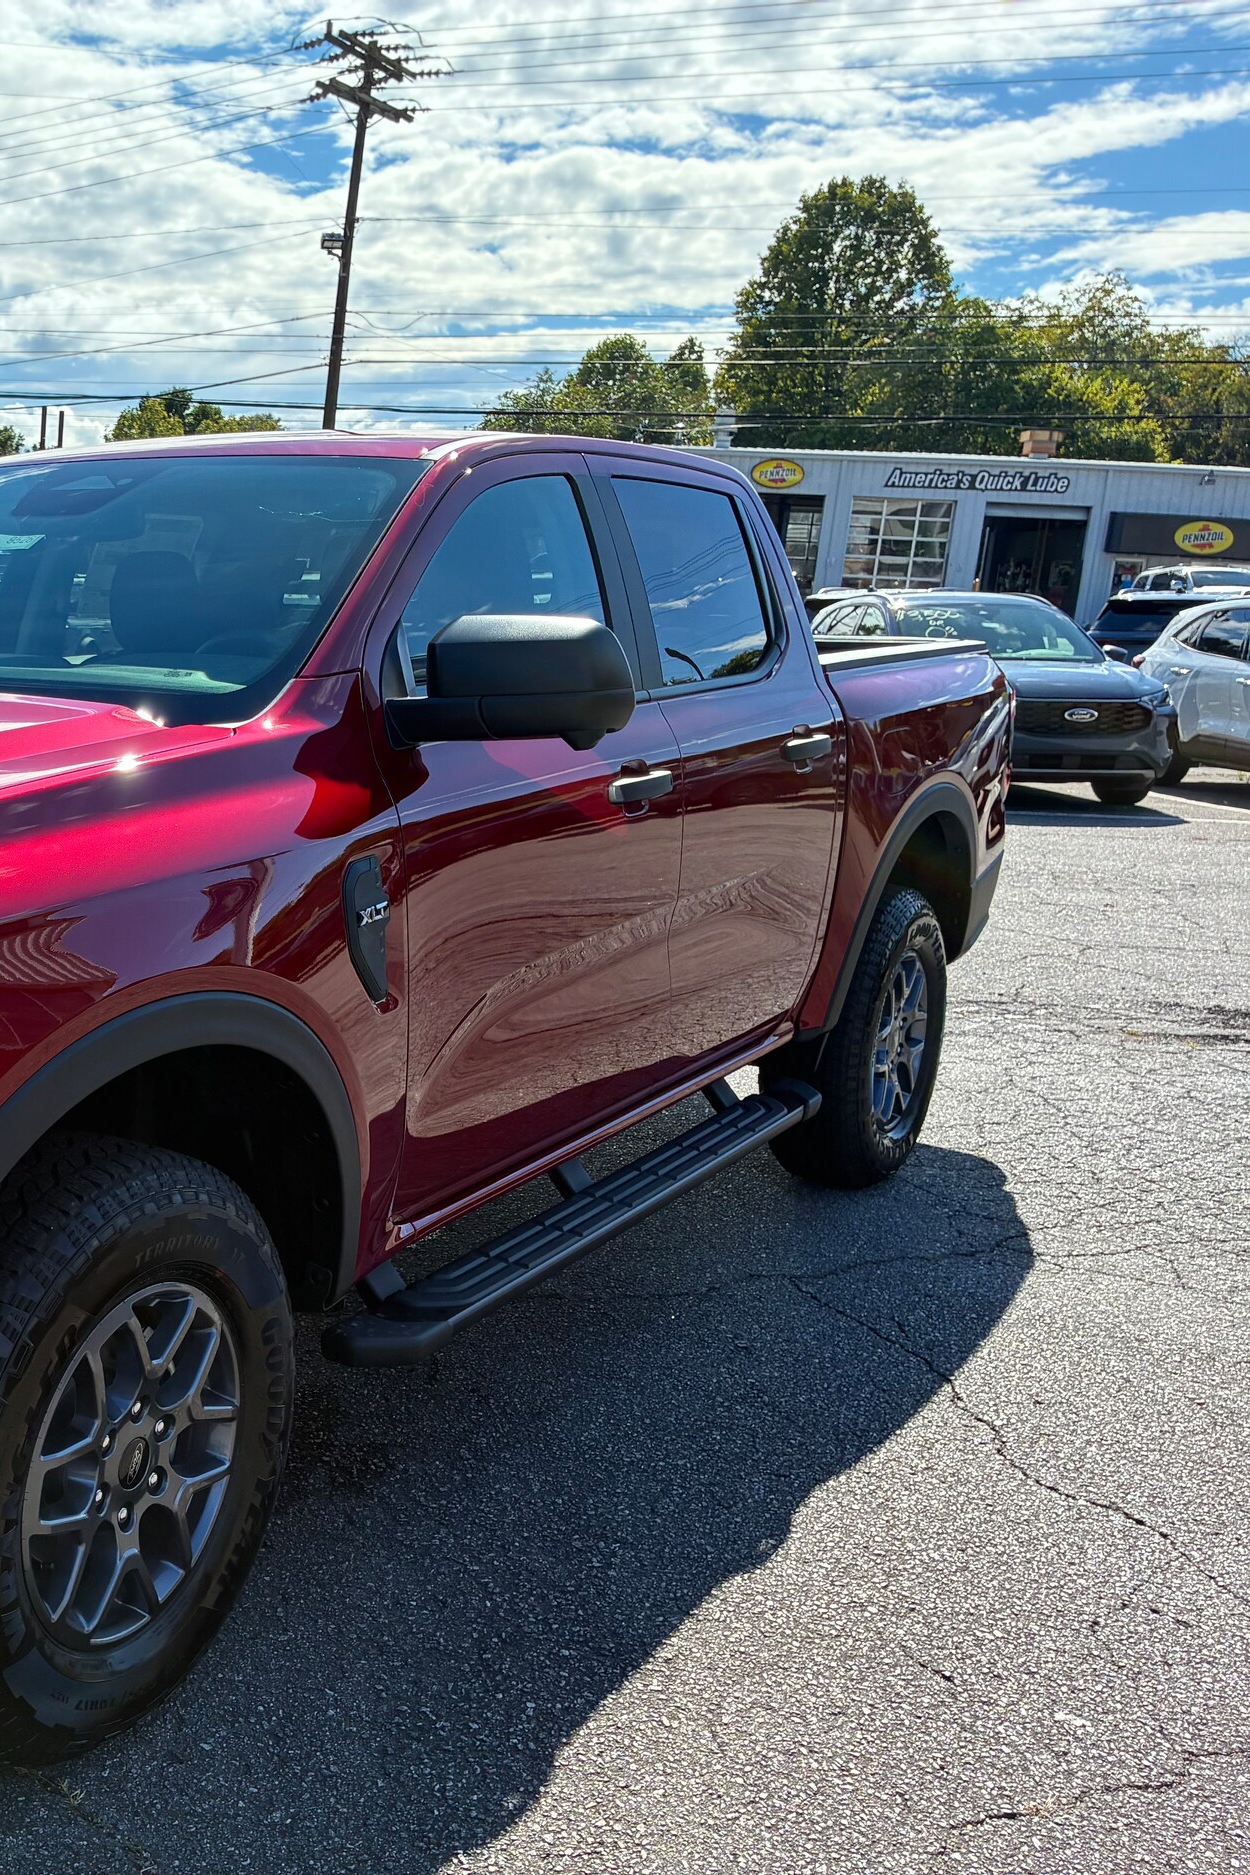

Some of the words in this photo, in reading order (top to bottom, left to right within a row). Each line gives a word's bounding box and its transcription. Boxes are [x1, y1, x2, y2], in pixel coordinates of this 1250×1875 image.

[758, 468, 797, 479] PENNZOIL
[886, 468, 971, 489] America's
[974, 470, 1024, 491] Quick
[1026, 472, 1069, 492] Lube
[1181, 530, 1225, 544] PENNZOIL
[359, 900, 389, 927] XLT
[134, 1234, 222, 1269] TERRITORY
